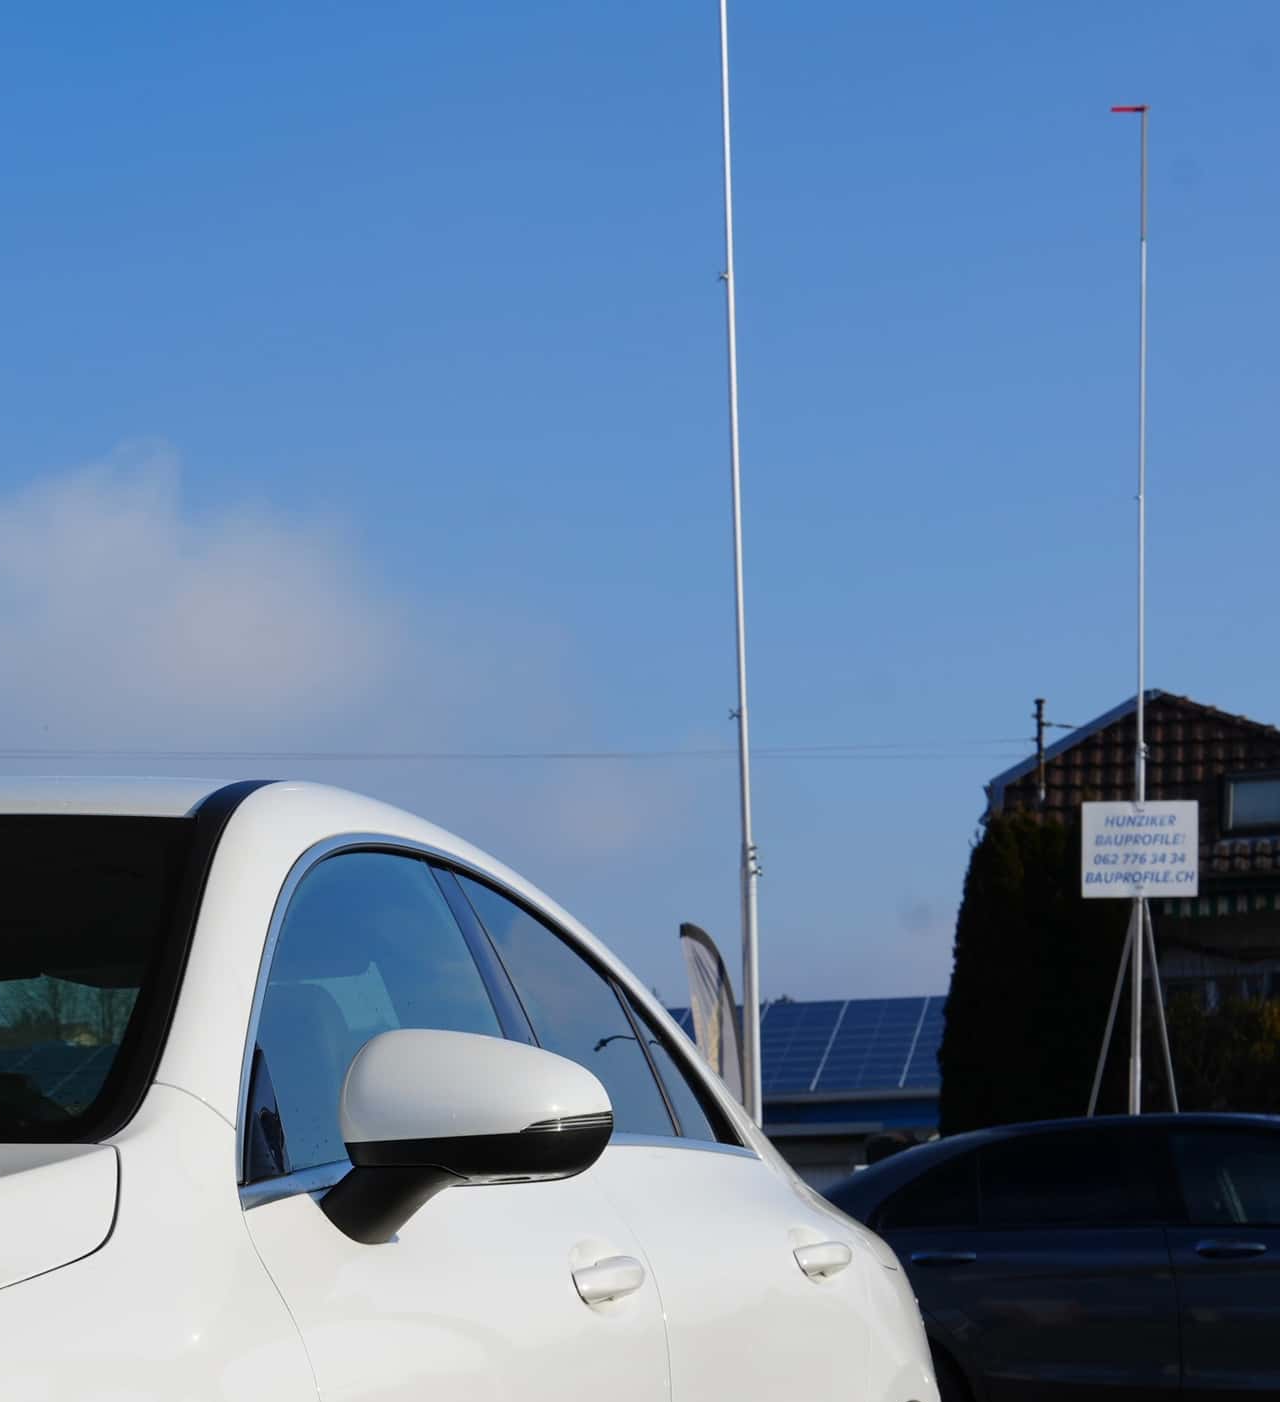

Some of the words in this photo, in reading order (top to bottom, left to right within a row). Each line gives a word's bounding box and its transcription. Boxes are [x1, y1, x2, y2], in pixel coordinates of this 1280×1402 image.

[1104, 814, 1177, 828] HUNZIKER
[1093, 853, 1120, 866] 062
[1123, 853, 1147, 865] 776
[1151, 852, 1167, 865] 34
[1170, 852, 1186, 865] 34
[1085, 871, 1195, 884] BAUPROFILE.CH
